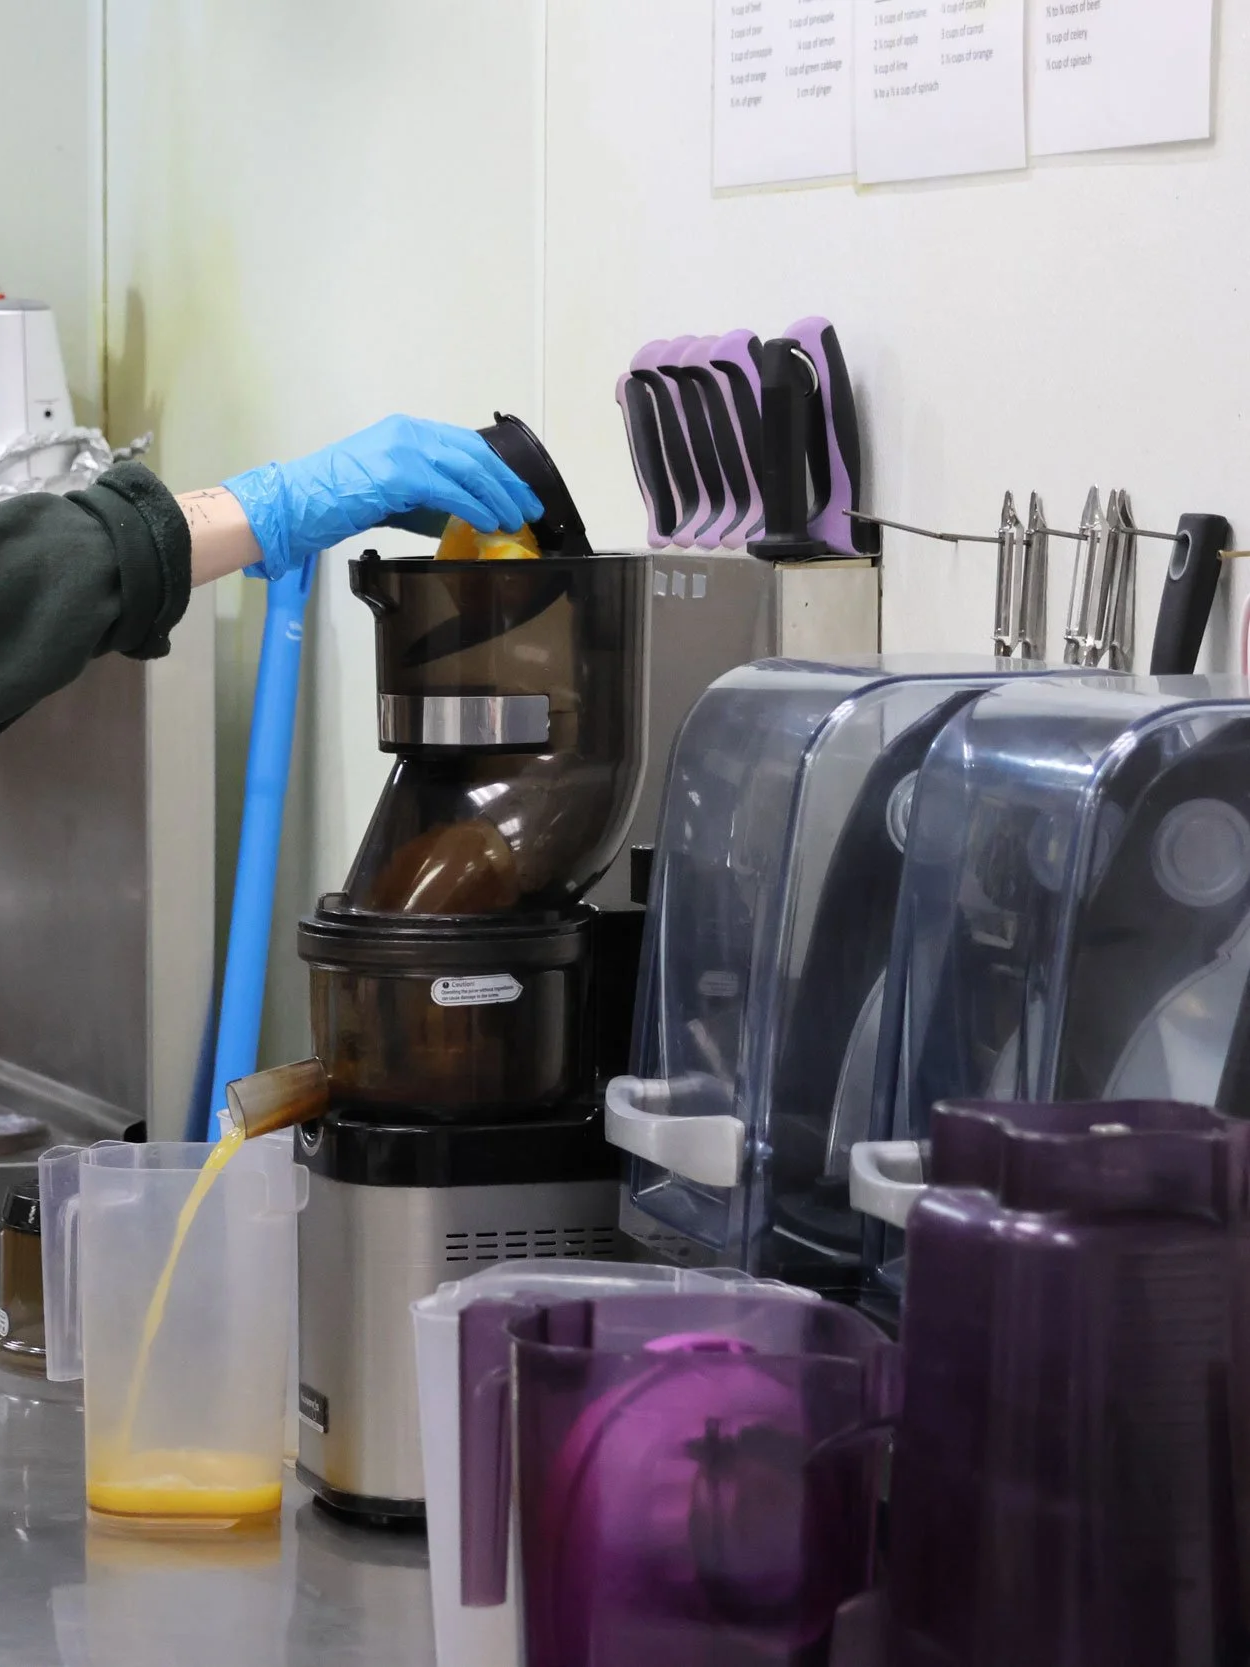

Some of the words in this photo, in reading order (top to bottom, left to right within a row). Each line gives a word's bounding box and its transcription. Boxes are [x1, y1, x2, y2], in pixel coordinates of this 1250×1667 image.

[959, 0, 964, 11] of
[1052, 7, 1059, 17] to
[1065, 4, 1078, 16] cups
[1079, 0, 1086, 13] of
[1086, 0, 1101, 11] beet
[803, 15, 808, 26] of
[809, 12, 835, 26] pineapple
[884, 14, 896, 24] cups
[897, 11, 903, 22] of
[904, 9, 927, 20] romaine
[945, 29, 959, 39] cups
[960, 24, 966, 37] of
[966, 24, 984, 35] carrot
[1052, 34, 1062, 46] cup
[1063, 28, 1069, 41] of
[1070, 29, 1088, 40] celery
[813, 38, 818, 48] of
[819, 37, 835, 48] lemon
[884, 39, 895, 50] cups
[897, 35, 902, 46] of
[903, 33, 918, 46] apple
[951, 54, 965, 64] cups
[965, 49, 972, 61] of
[972, 49, 994, 61] orange
[1052, 60, 1062, 71] cup
[1063, 56, 1069, 68] of
[1070, 53, 1092, 69] spinach
[799, 63, 804, 74] of
[805, 63, 819, 75] green
[821, 60, 842, 71] cabbage
[879, 65, 889, 75] cup
[889, 60, 895, 72] of
[896, 60, 908, 70] lime
[810, 85, 815, 96] of
[816, 85, 832, 97] ginger
[900, 86, 910, 96] cup
[911, 82, 917, 94] of
[918, 80, 939, 94] spinach
